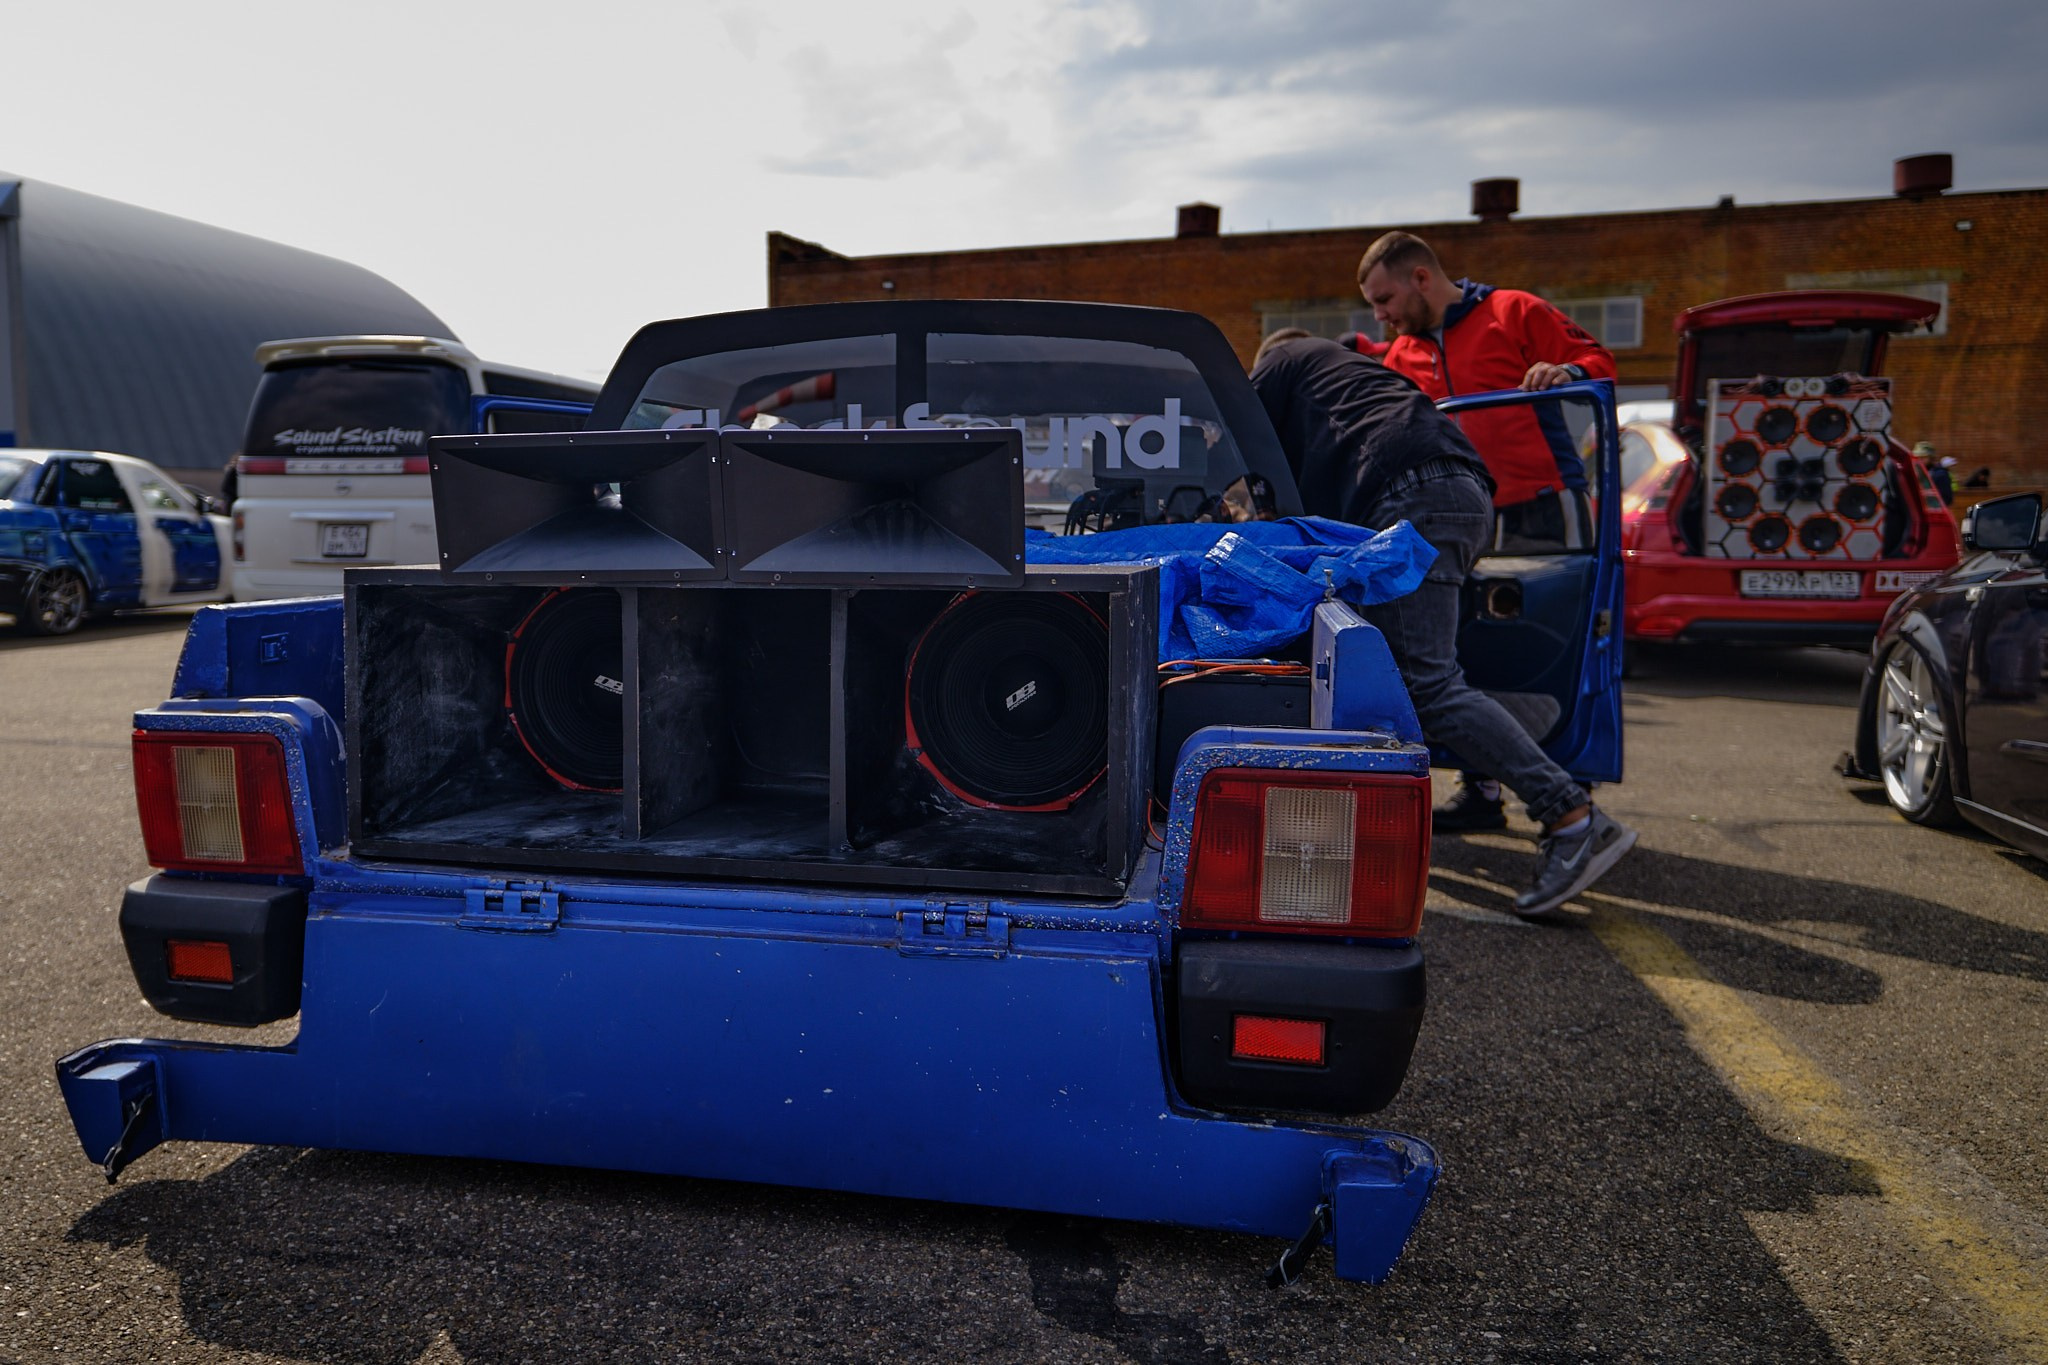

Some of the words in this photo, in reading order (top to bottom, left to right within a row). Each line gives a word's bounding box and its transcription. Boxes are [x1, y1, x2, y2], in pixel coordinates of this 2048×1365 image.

[274, 426, 343, 446] Sound
[341, 426, 424, 446] System
[903, 398, 1181, 470] und
